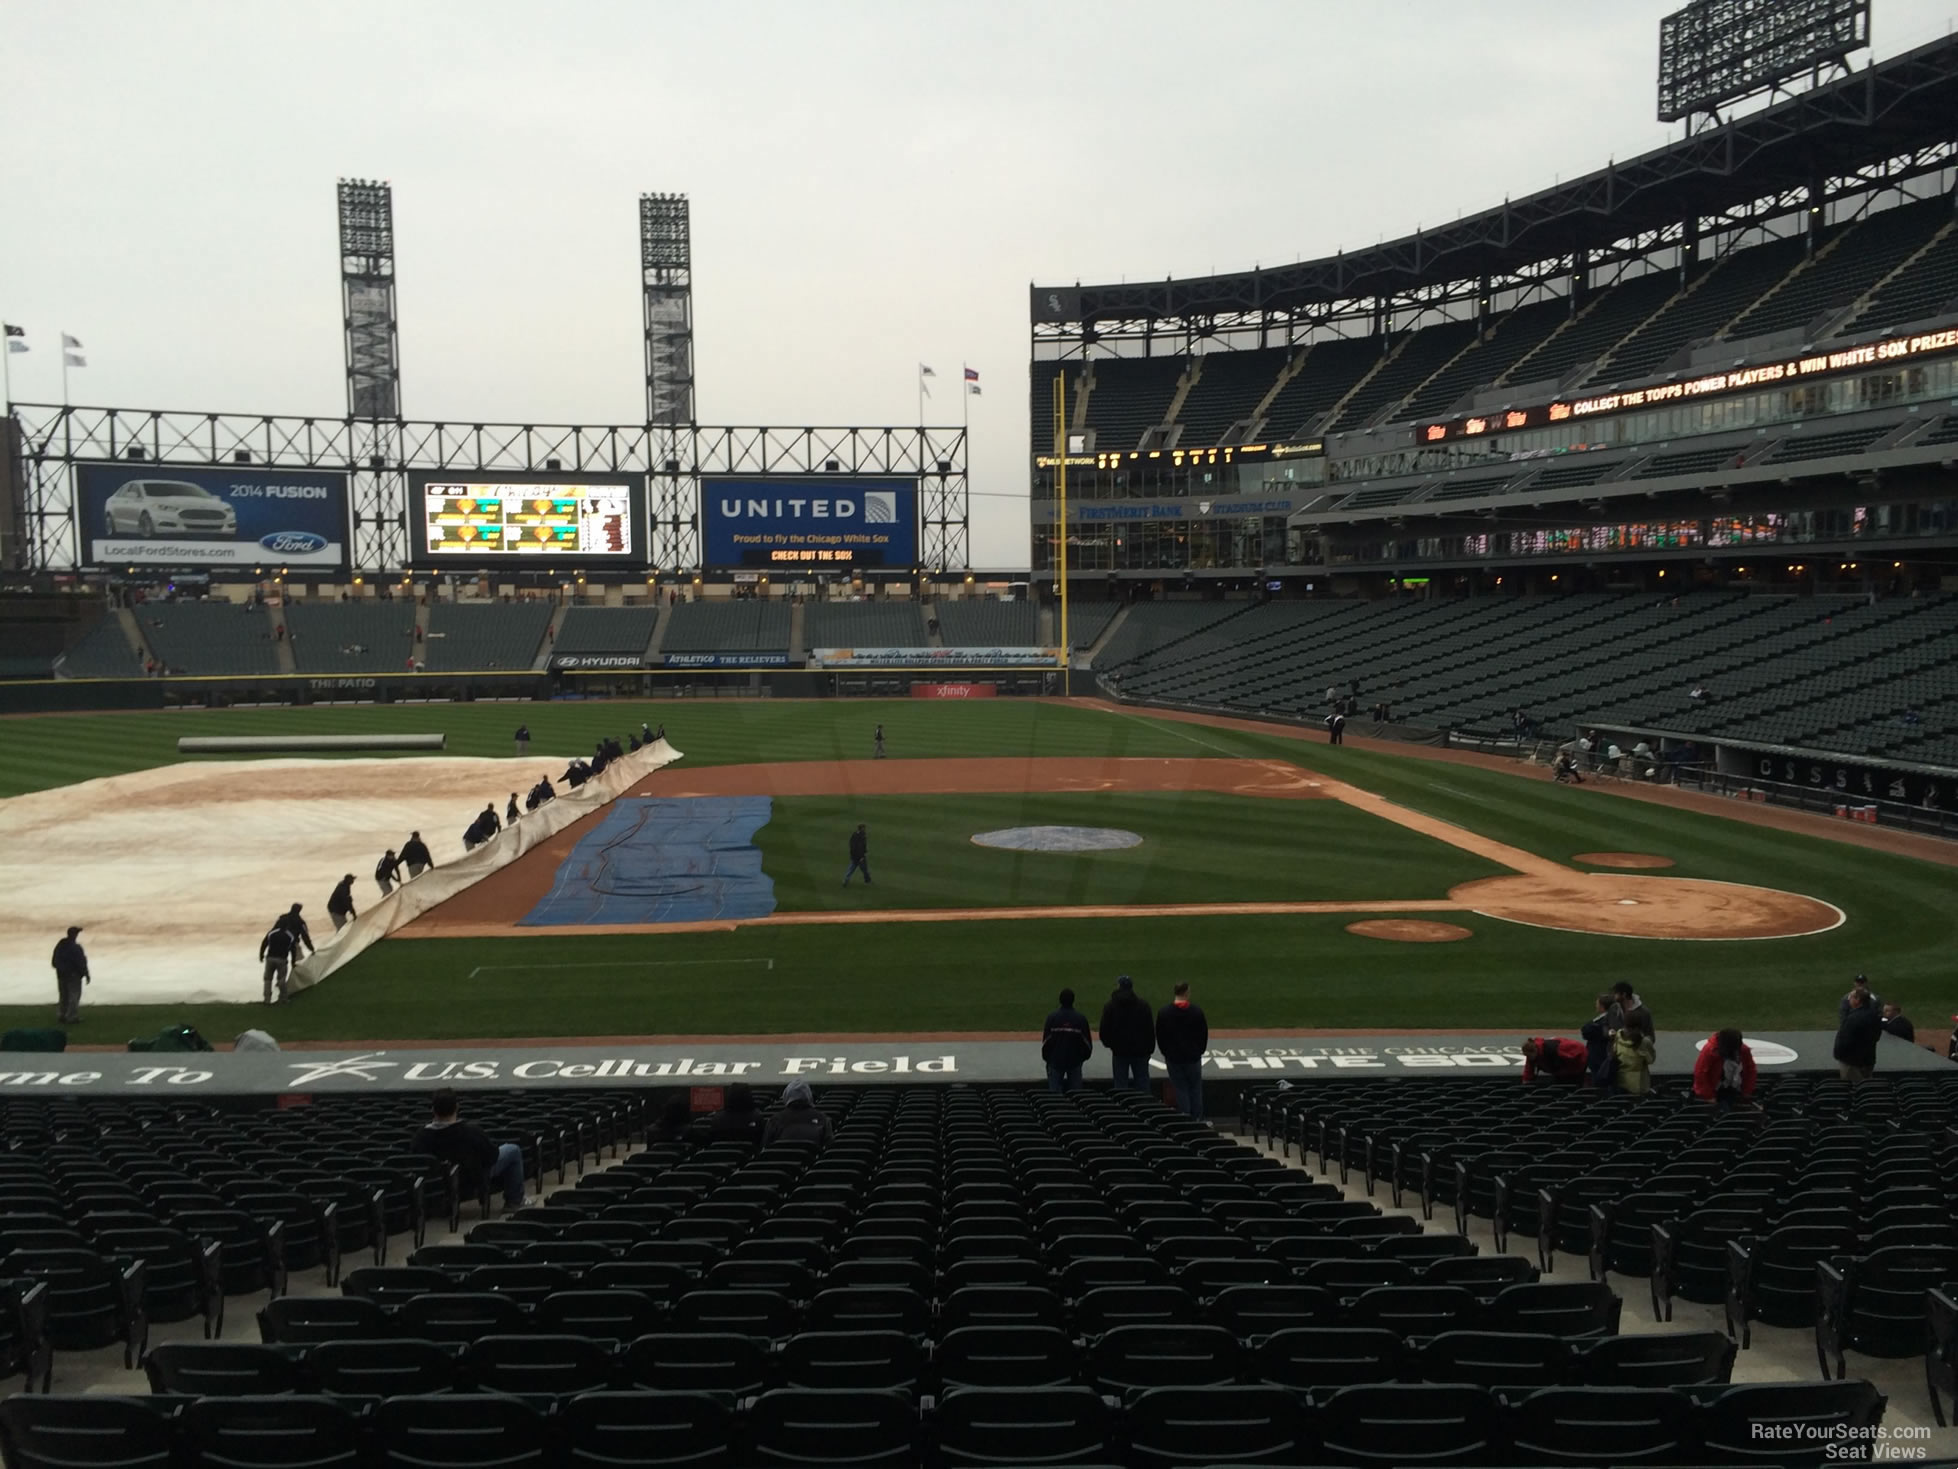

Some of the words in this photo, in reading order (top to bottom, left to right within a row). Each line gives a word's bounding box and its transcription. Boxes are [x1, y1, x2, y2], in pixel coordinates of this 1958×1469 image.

[1573, 400, 1620, 415] COLLECT
[1622, 391, 1645, 407] THE
[1645, 384, 1683, 402] TOPPS
[1684, 376, 1727, 396] POWER
[1727, 364, 1784, 388] PLAYERS
[1786, 362, 1797, 376] &
[1799, 356, 1828, 374] WIN
[1829, 346, 1875, 368] WHITE
[1877, 341, 1908, 360] SOX
[1911, 330, 1958, 352] PRIZE
[229, 485, 263, 497] 2014
[265, 486, 327, 498] FUSION
[721, 499, 856, 517] UNITED
[272, 535, 315, 551] Ford
[733, 534, 761, 544] Proud
[763, 535, 773, 544] to
[775, 534, 788, 545] fly
[790, 534, 805, 544] the
[806, 534, 842, 545] Chicago
[843, 534, 871, 544] White
[872, 534, 889, 544] Sox
[104, 545, 235, 557] LocalFordStores.com
[771, 551, 799, 561] CHECK
[800, 551, 816, 560] OUT
[818, 551, 834, 560] THE
[834, 551, 853, 560] SOX
[581, 656, 640, 666] HYUNDAI
[720, 656, 738, 664] THE
[739, 655, 786, 664] RELIEVERS
[338, 678, 376, 688] PATIO
[937, 685, 971, 697] xfinity
[1265, 1048, 1303, 1056] OF
[1312, 1047, 1378, 1055] THE
[403, 1061, 500, 1080] U.S.
[512, 1057, 761, 1079] Cellular
[778, 1056, 960, 1074] Field
[125, 1067, 213, 1085] To
